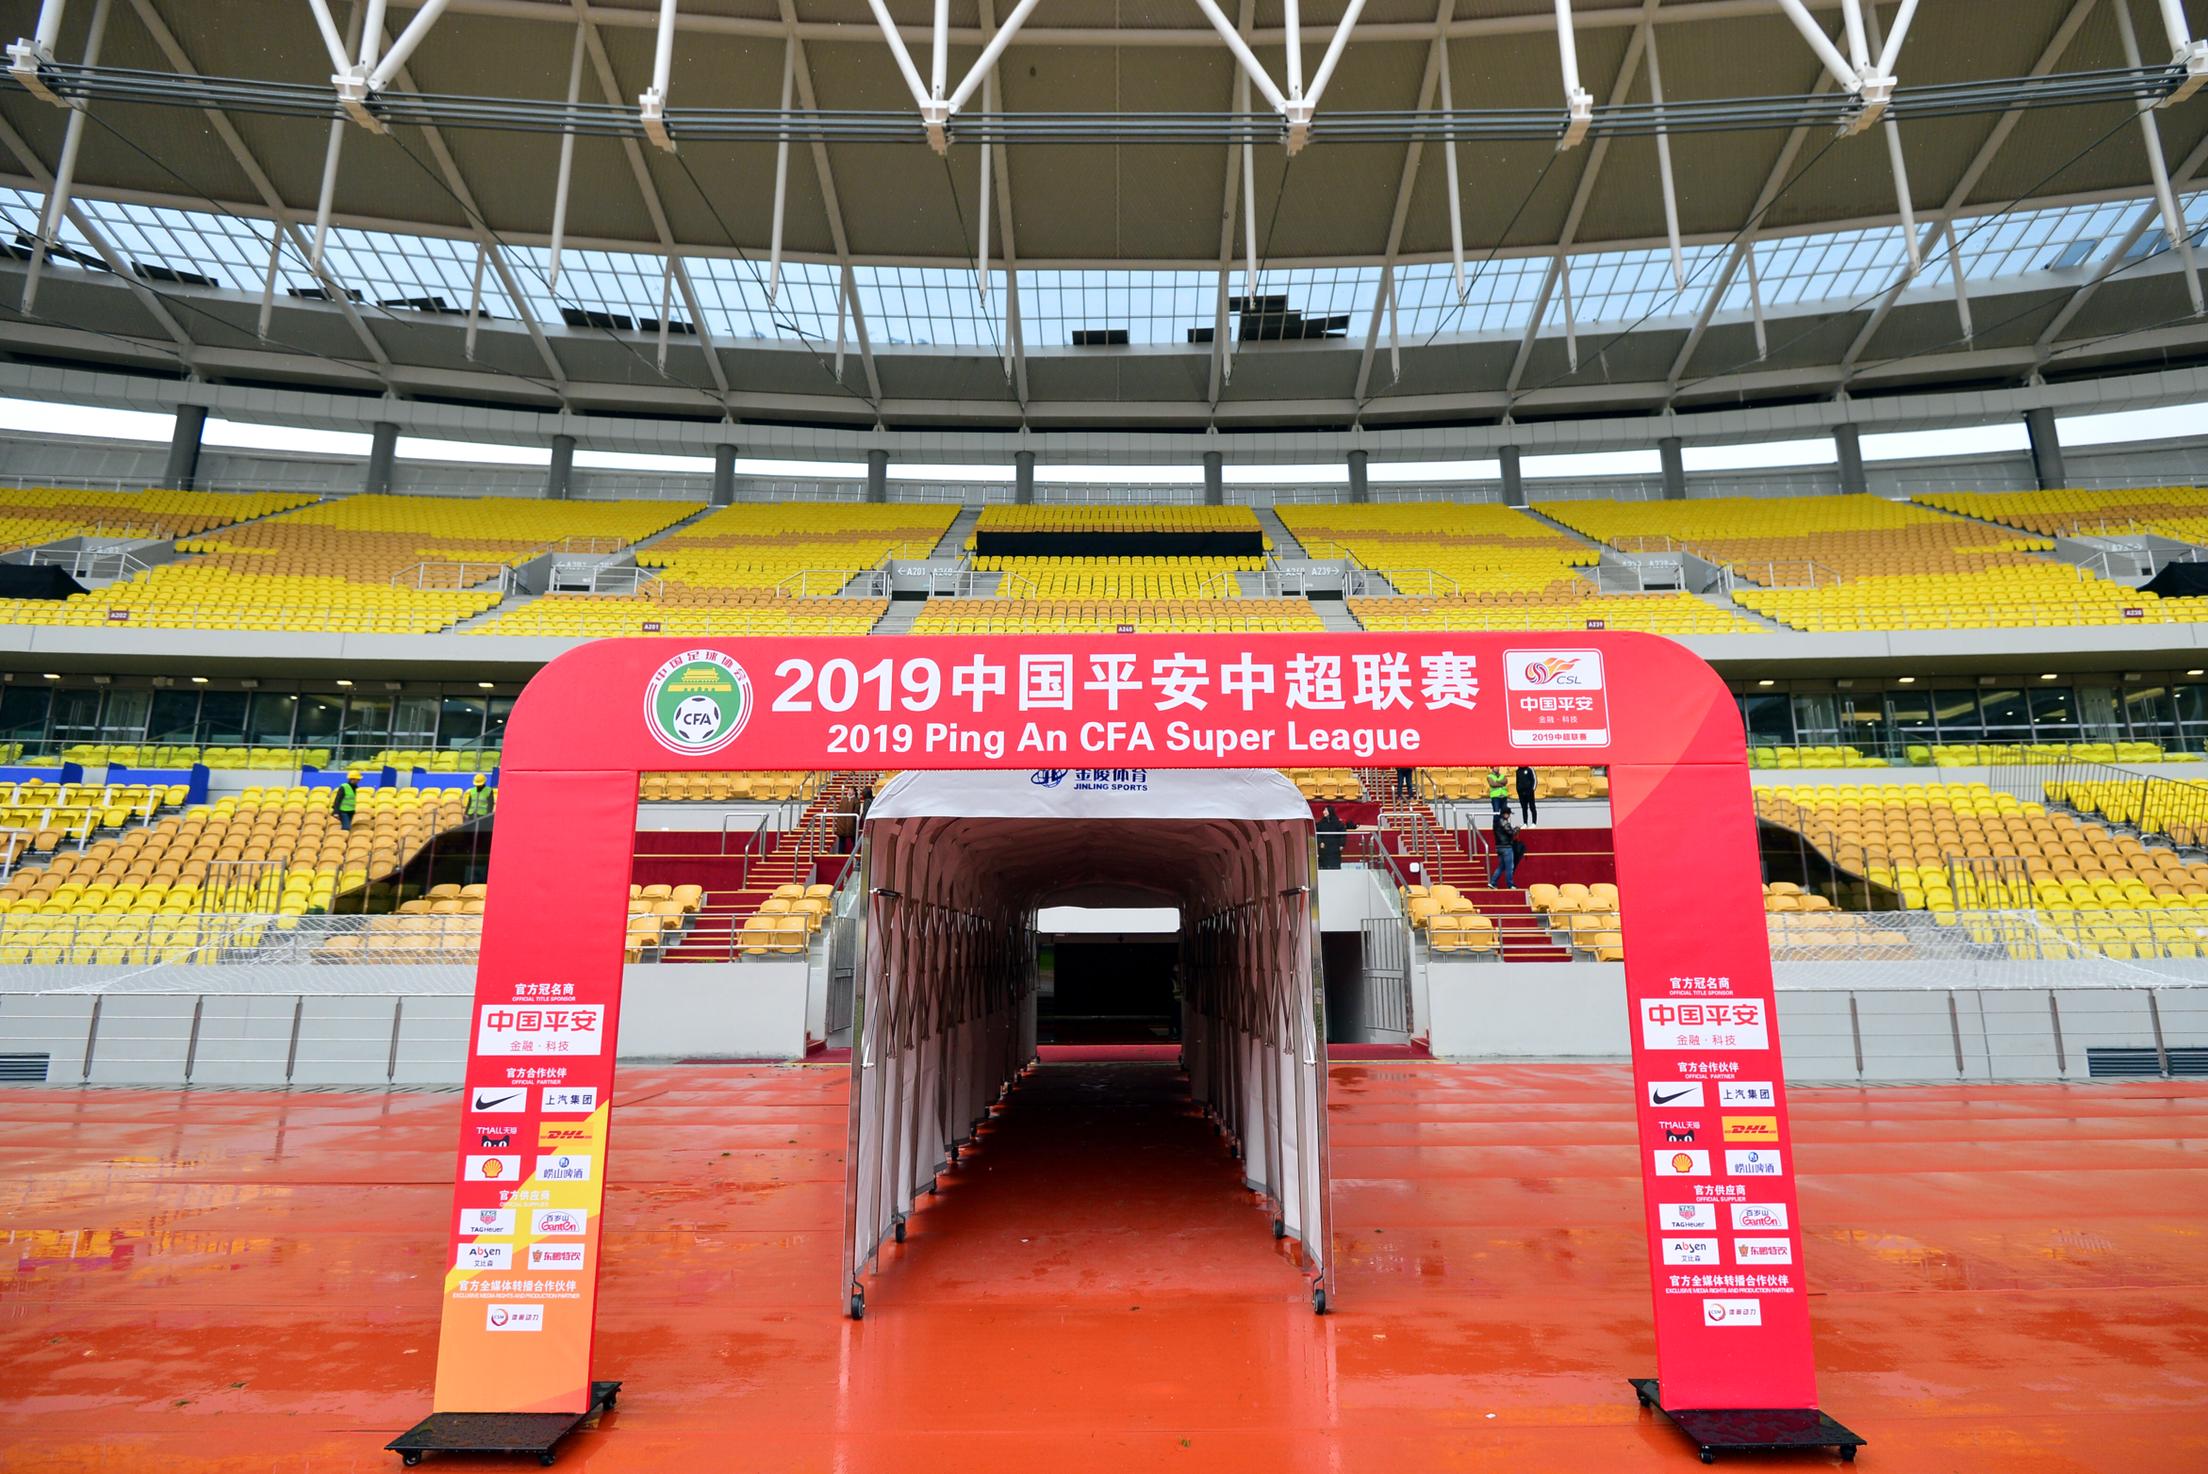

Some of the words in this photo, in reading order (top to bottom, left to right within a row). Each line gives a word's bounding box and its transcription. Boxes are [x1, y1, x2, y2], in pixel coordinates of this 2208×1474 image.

[907, 567, 926, 576] A201
[1311, 566, 1331, 576] A239
[771, 651, 1480, 713] 2019中国平安中超联赛
[1556, 675, 1582, 685] CSL
[1520, 696, 1594, 712] 中国平安
[683, 713, 712, 726] CFA
[827, 723, 913, 753] 2019
[925, 722, 1005, 759] Ping
[1016, 721, 1068, 752] An
[1079, 720, 1155, 752] CFA
[1166, 720, 1276, 758] Super
[1288, 720, 1421, 758] League
[1073, 783, 1110, 791] JINLING
[1111, 783, 1148, 792] SPORTS
[1669, 977, 1730, 990] 官方冠名商
[515, 983, 575, 996] 官方冠名商
[1648, 1004, 1759, 1026] 中国平安
[487, 1010, 597, 1032] 中国平安
[506, 1067, 567, 1078] 官方合作伙伴
[1677, 1062, 1739, 1073] 官方合作伙伴
[545, 1094, 593, 1105] 上汽集团
[1723, 1089, 1770, 1100] 上汽集团
[547, 1130, 584, 1139] DHL
[1731, 1125, 1769, 1134] DHL
[1694, 1185, 1746, 1196] 官方供应商
[458, 1280, 577, 1292] 官方全媒体转播合作伙伴
[1669, 1274, 1789, 1287] 官方全媒体转播合作伙伴
